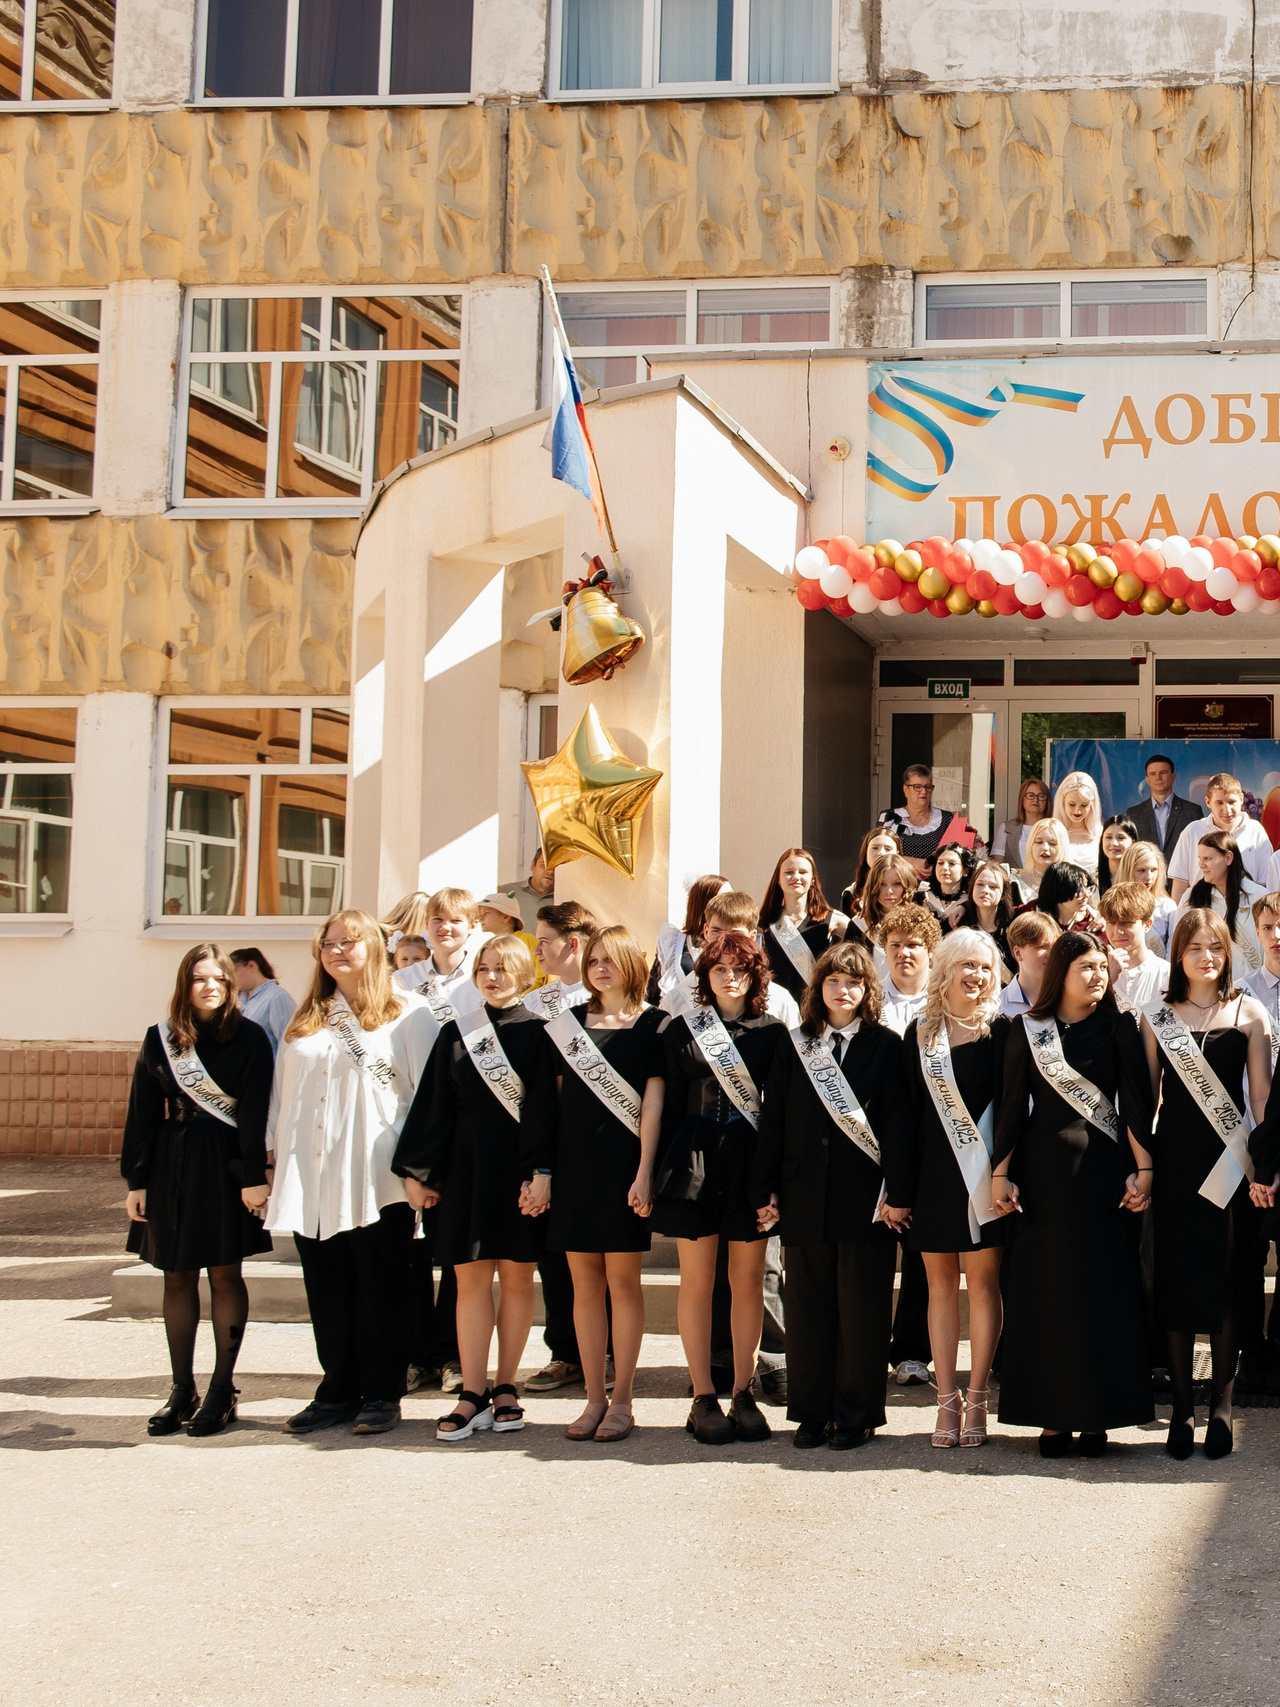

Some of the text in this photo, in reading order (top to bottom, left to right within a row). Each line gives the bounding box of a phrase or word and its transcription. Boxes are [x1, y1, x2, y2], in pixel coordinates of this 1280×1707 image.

[934, 683, 964, 697] ВХОД
[367, 1058, 396, 1084] 2025
[700, 1033, 754, 1112] Выпускник
[1038, 1051, 1102, 1121] Выпускник
[1160, 1027, 1241, 1130] Выпускник 2025
[952, 1117, 979, 1146] 2025
